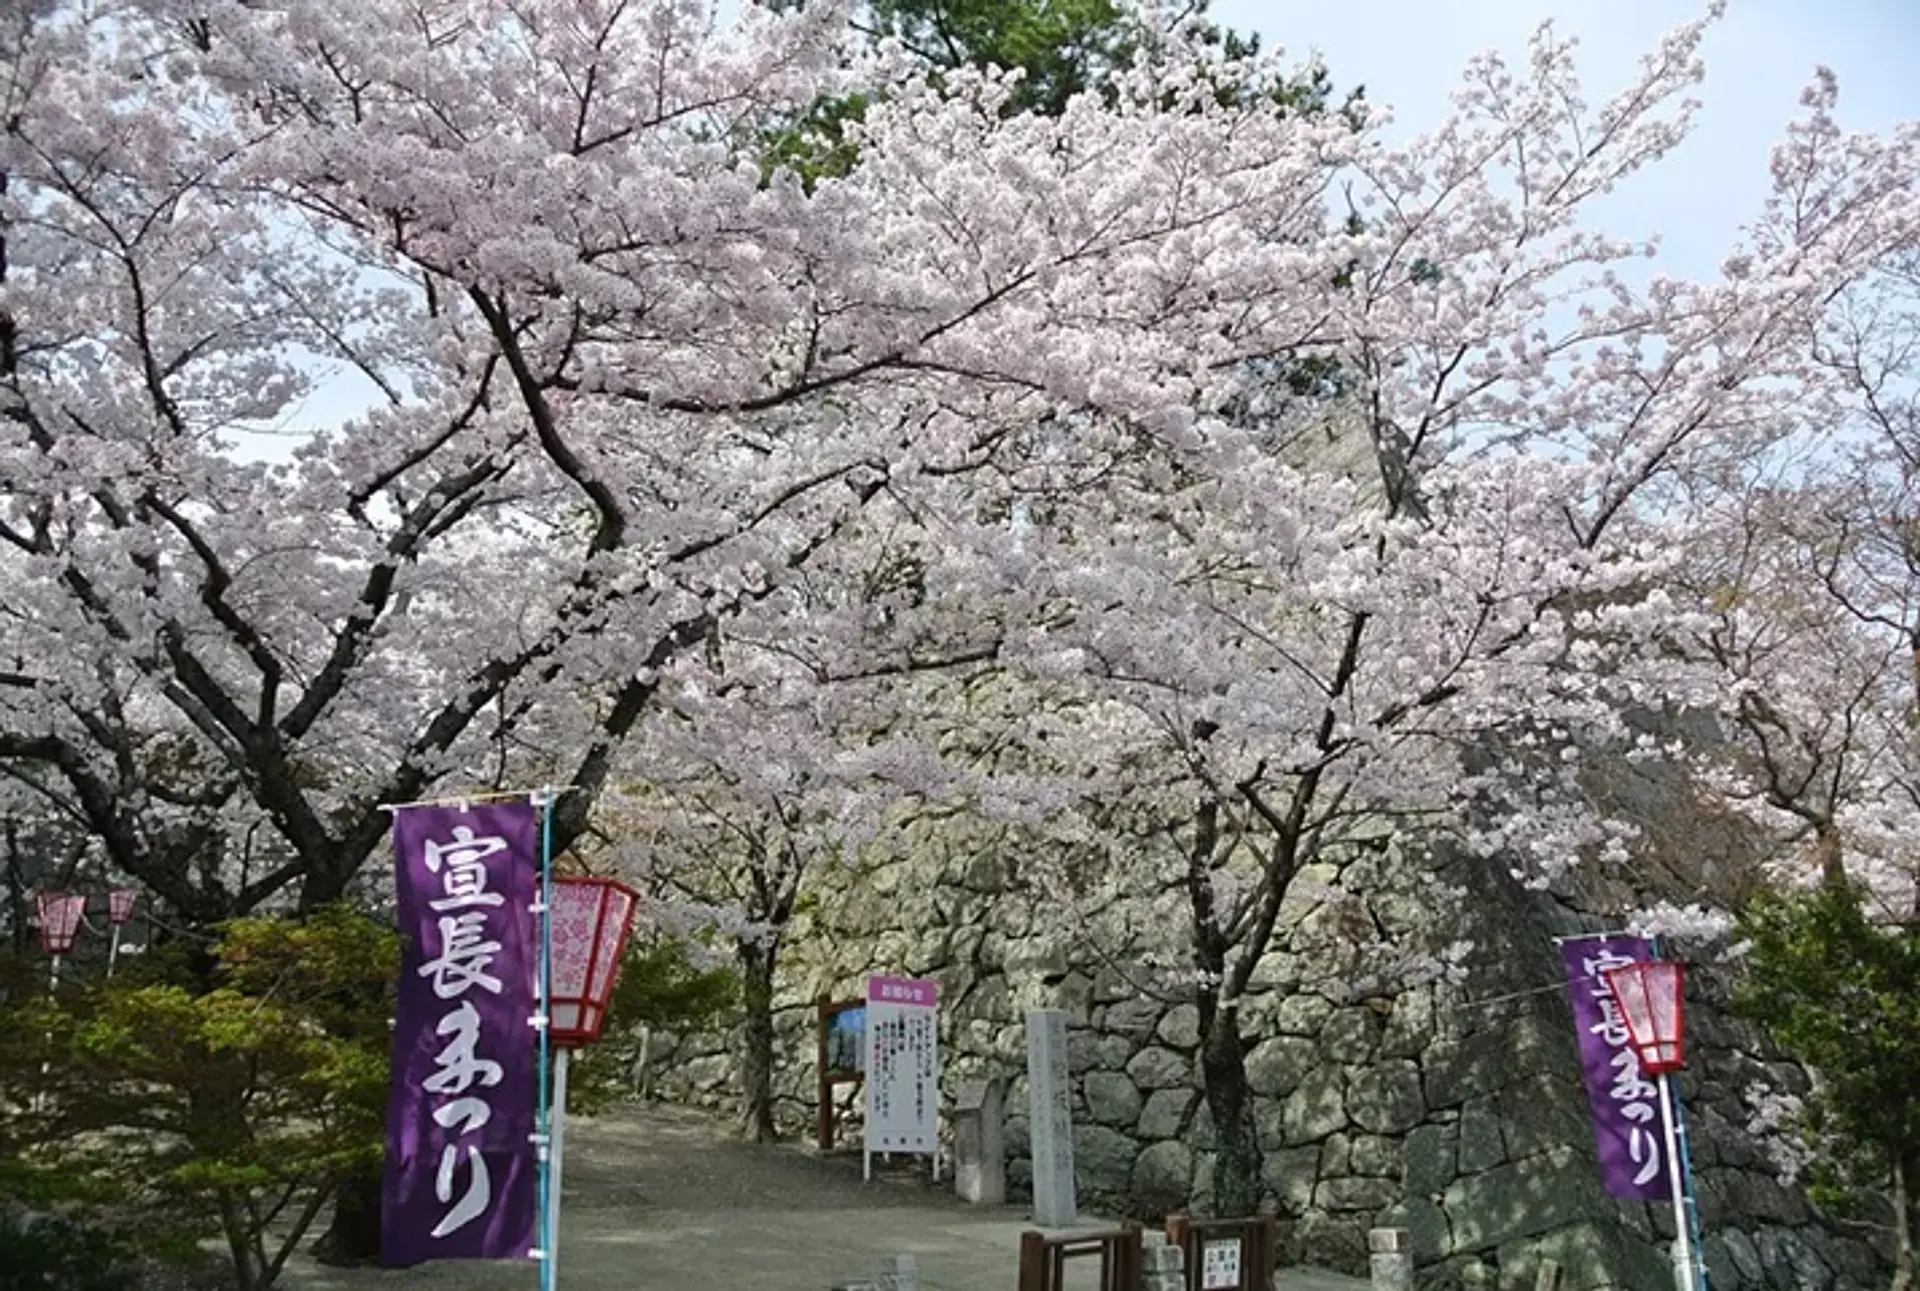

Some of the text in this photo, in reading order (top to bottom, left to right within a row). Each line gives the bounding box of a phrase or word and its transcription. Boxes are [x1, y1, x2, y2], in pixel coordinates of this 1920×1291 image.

[418, 826, 508, 1238] 宣長まつり
